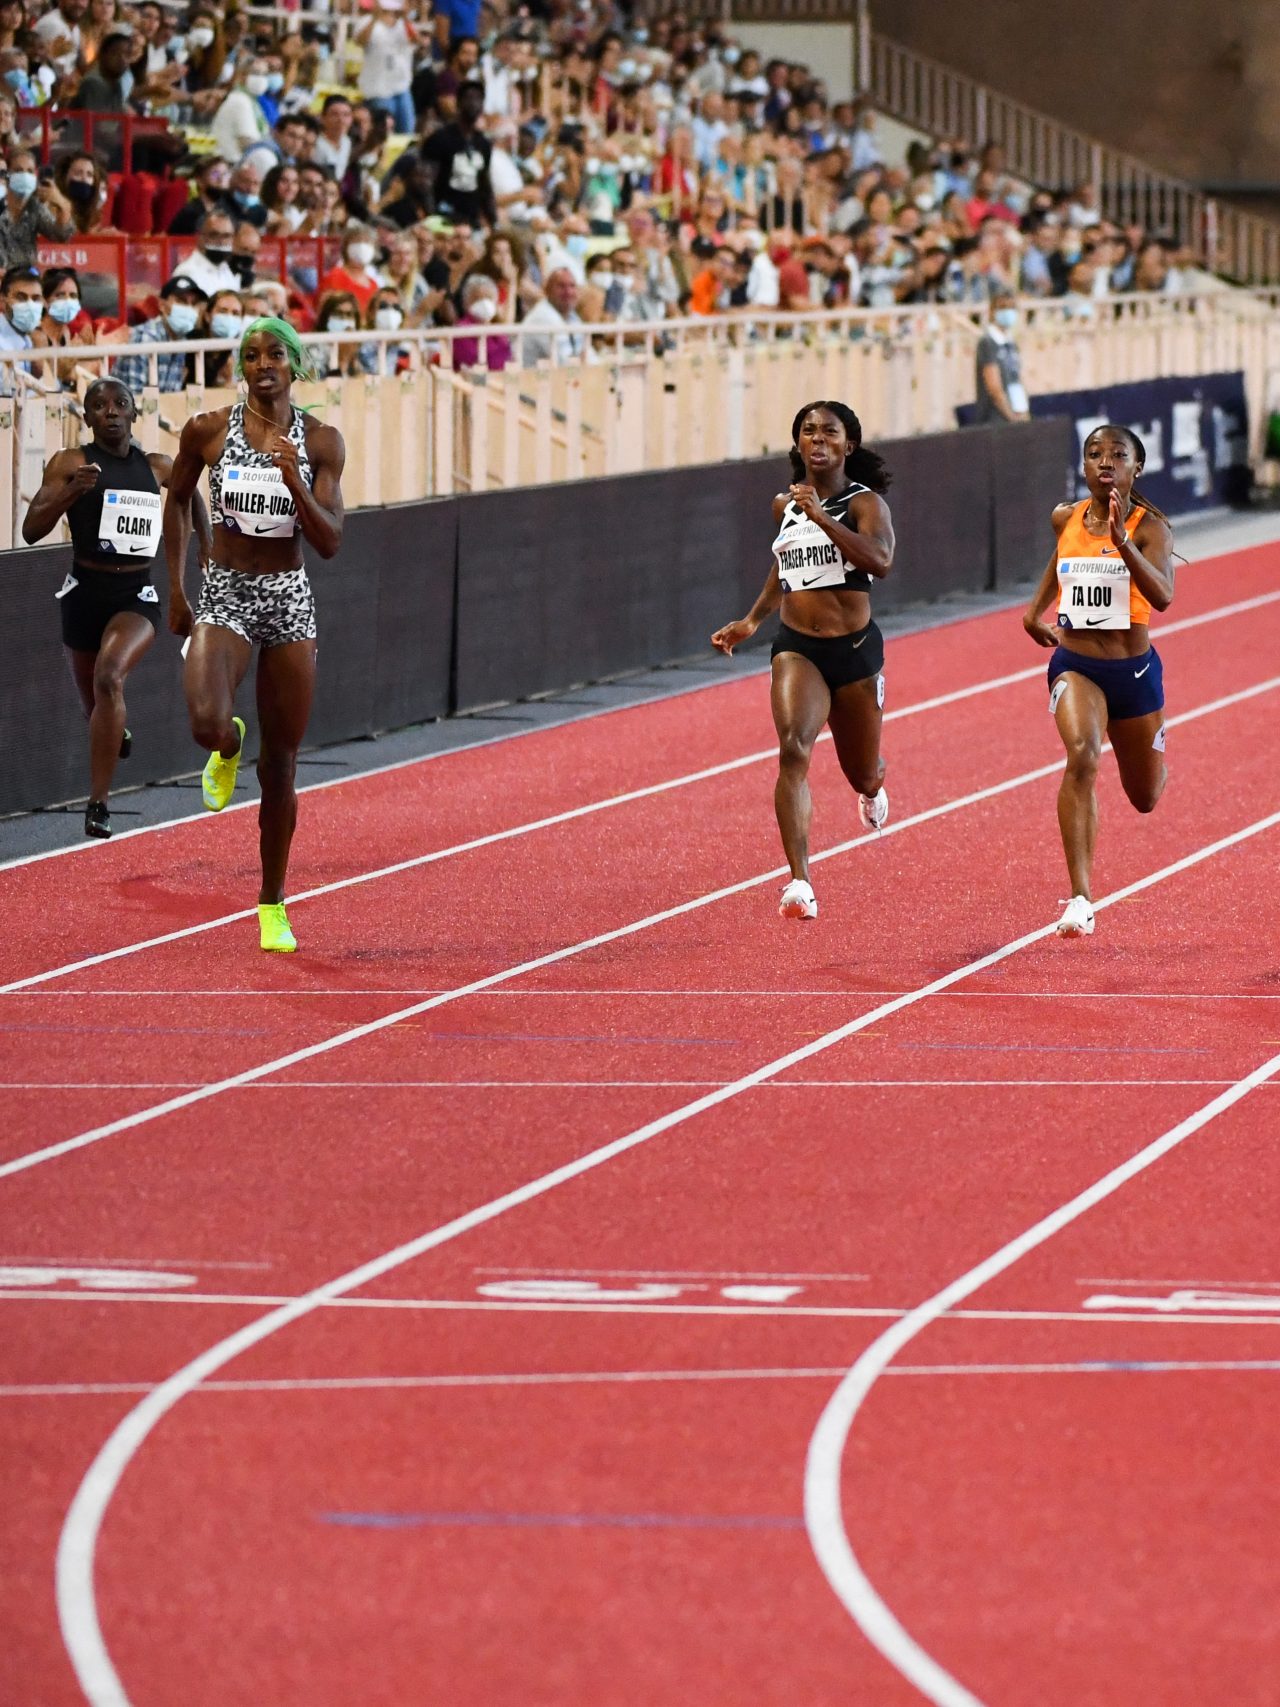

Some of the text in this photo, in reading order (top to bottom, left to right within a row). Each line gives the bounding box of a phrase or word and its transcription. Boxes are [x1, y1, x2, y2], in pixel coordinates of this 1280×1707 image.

[242, 472, 284, 483] SLOVENIJ
[116, 515, 153, 537] CLARK
[778, 544, 838, 571] FRASER-PRYCE
[1071, 562, 1127, 574] SLOVENIJALES
[1072, 586, 1112, 607] TA LOU
